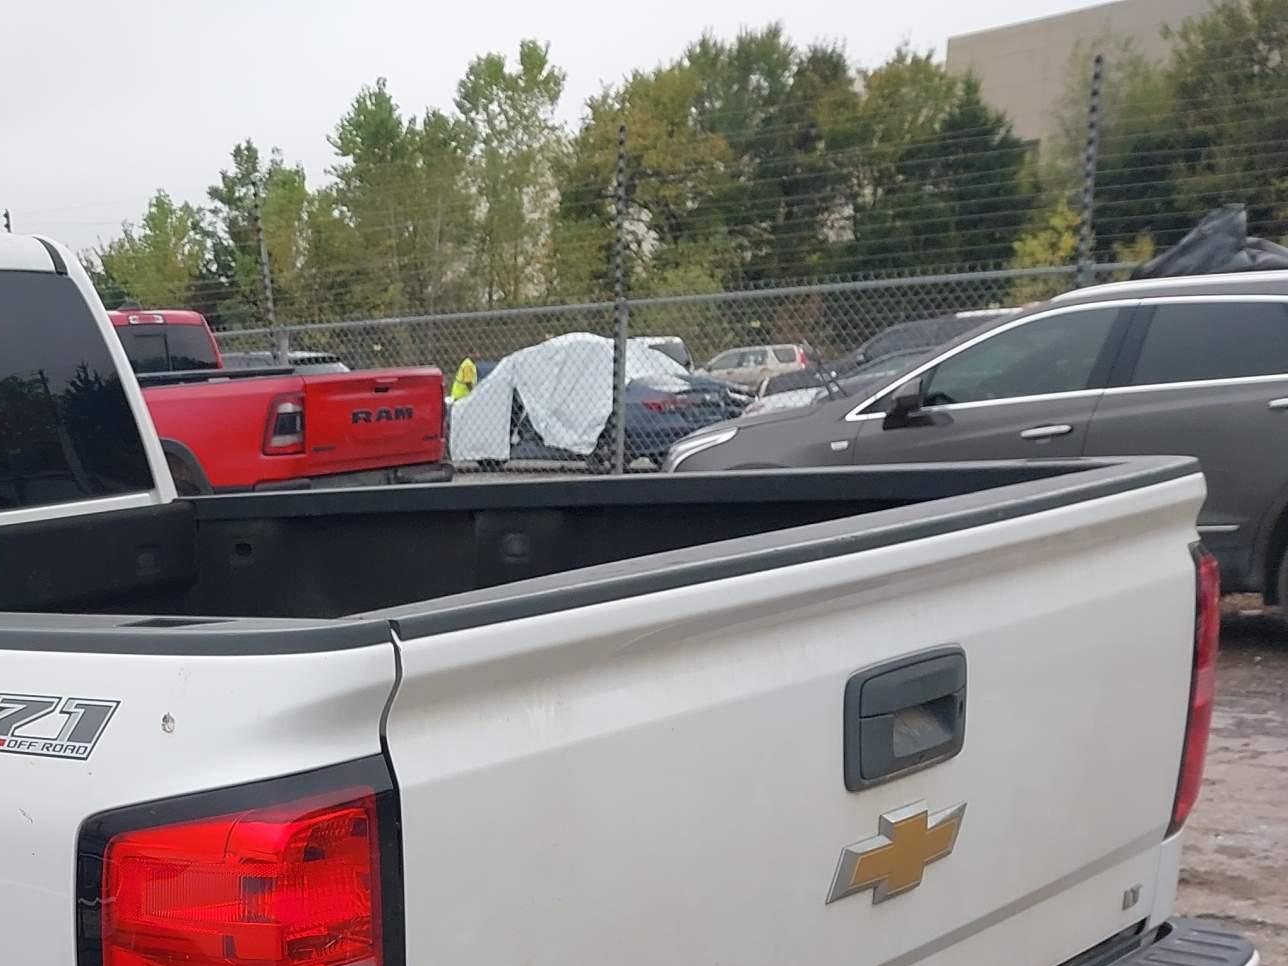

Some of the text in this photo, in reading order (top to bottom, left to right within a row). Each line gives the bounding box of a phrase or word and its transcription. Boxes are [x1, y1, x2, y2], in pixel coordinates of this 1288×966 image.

[351, 407, 413, 424] RAM
[6, 739, 88, 755] OFF ROAD
